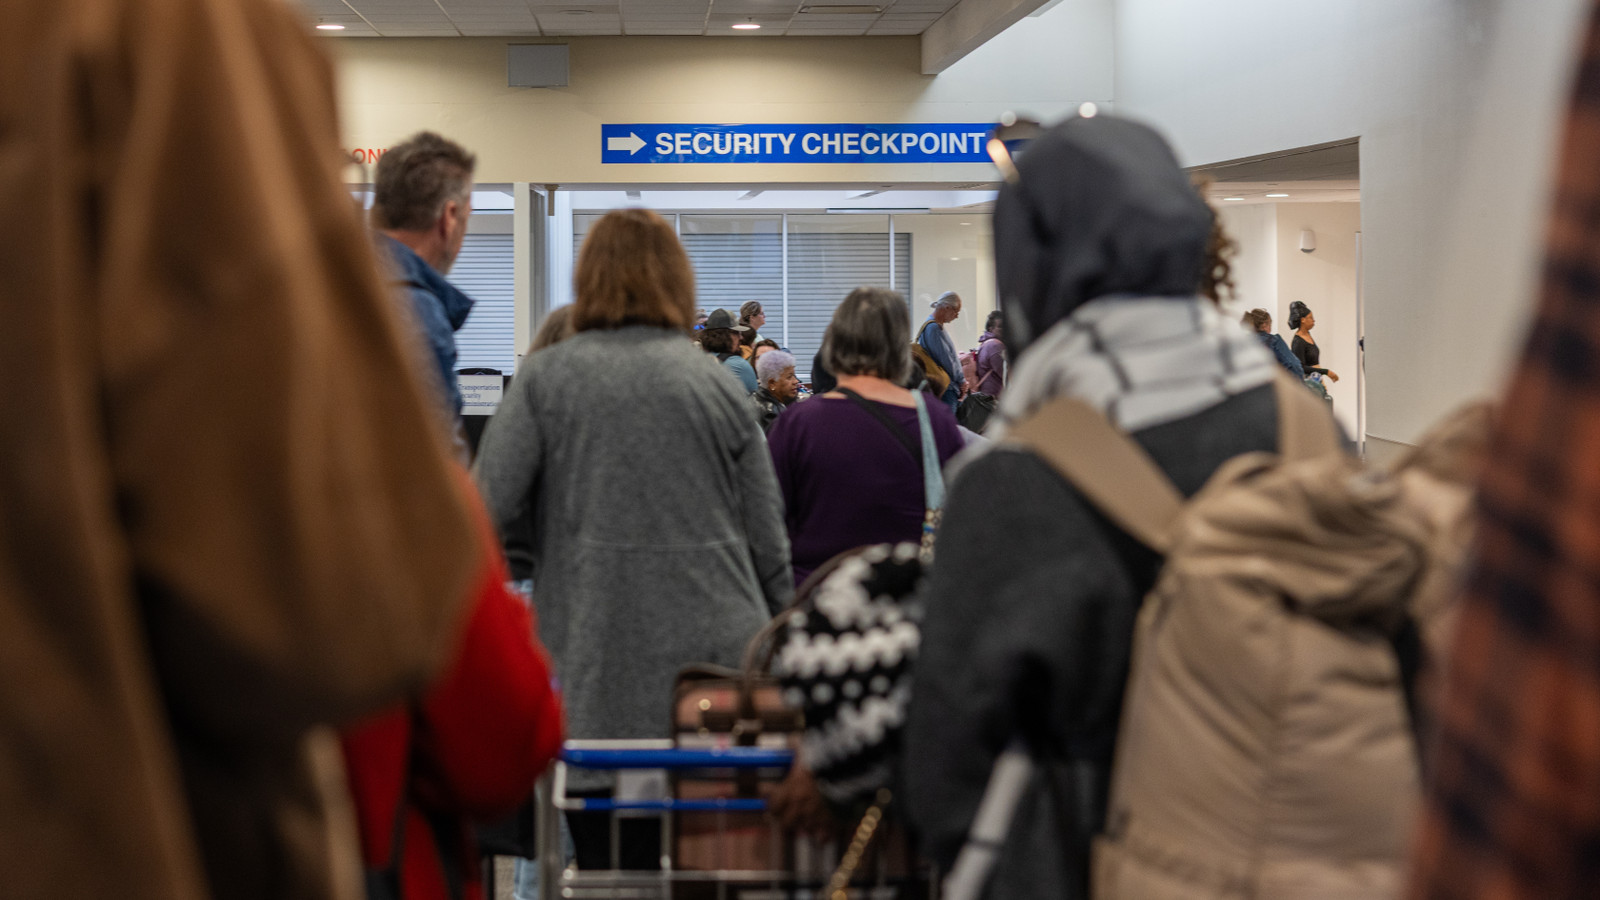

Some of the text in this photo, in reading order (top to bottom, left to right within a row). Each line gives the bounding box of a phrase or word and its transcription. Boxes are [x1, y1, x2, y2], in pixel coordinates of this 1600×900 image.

[655, 132, 986, 155] SECURITY CHECKPOINT
[457, 383, 501, 392] Transportation
